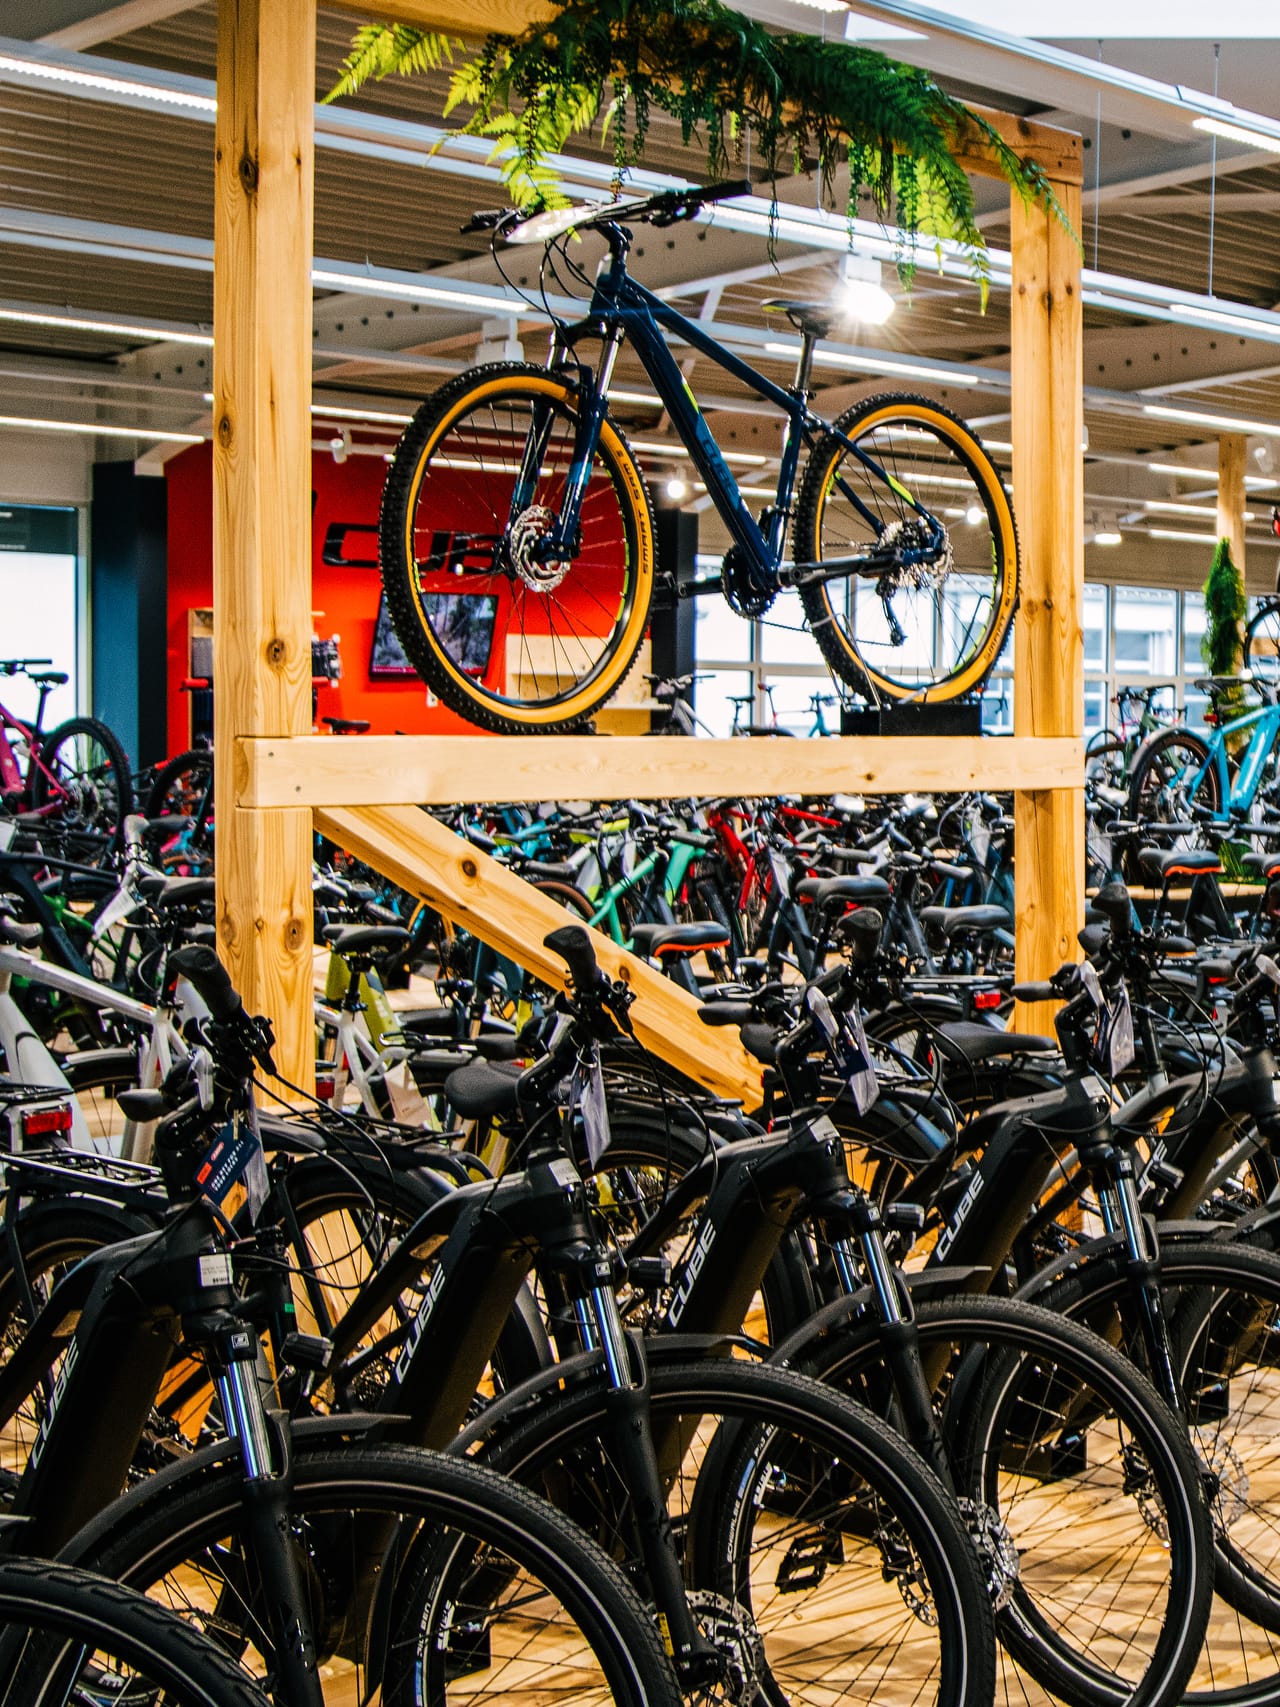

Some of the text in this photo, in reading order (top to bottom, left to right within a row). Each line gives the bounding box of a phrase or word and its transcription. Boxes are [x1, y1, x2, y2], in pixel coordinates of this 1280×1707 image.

[638, 509, 650, 575] SMART
[936, 1169, 985, 1262] CUBE
[395, 1262, 446, 1384] CUBE
[668, 1218, 717, 1328] CUBE
[32, 1335, 79, 1470] CUBE
[726, 1499, 741, 1563] SCHWALBE
